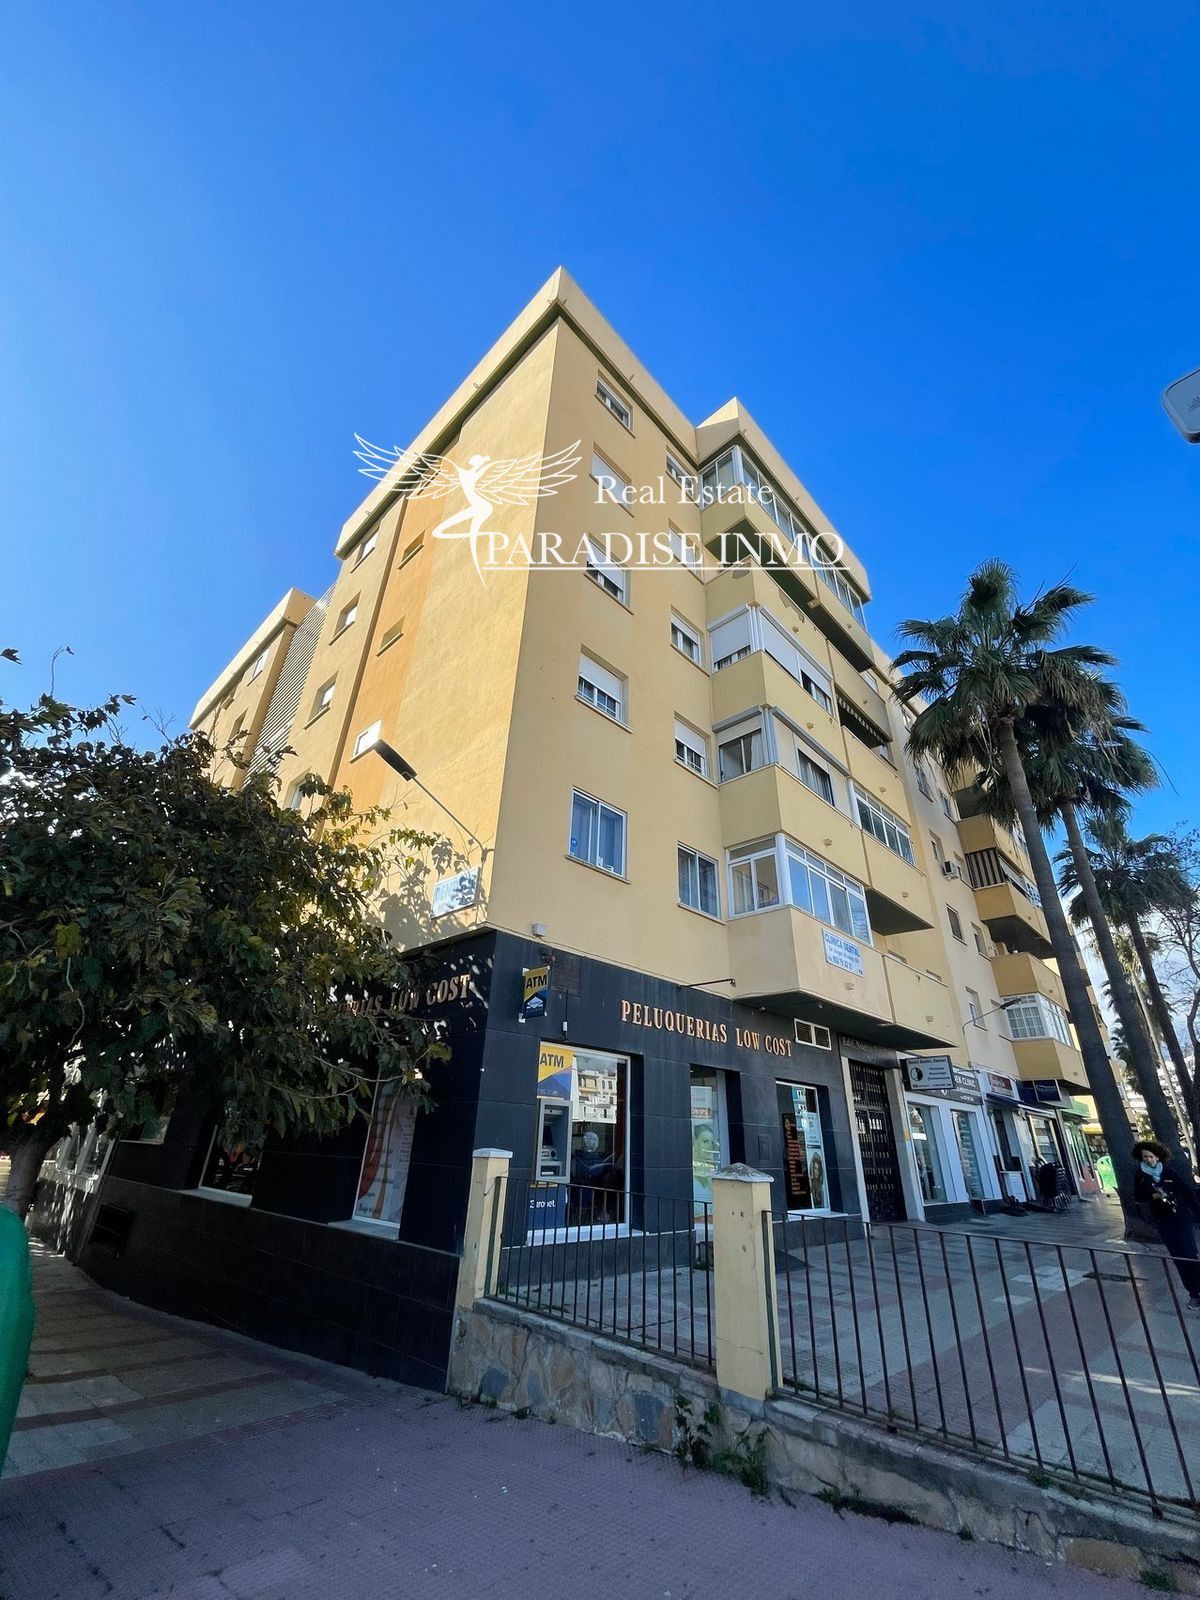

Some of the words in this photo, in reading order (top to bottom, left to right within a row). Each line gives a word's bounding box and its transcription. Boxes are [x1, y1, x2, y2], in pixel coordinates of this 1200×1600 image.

[426, 974, 471, 1006] COST
[525, 975, 547, 989] ATM
[621, 1000, 728, 1043] PELUQUERIAS
[736, 1027, 761, 1049] LOW
[765, 1035, 792, 1057] COST
[540, 1053, 564, 1068] ATM
